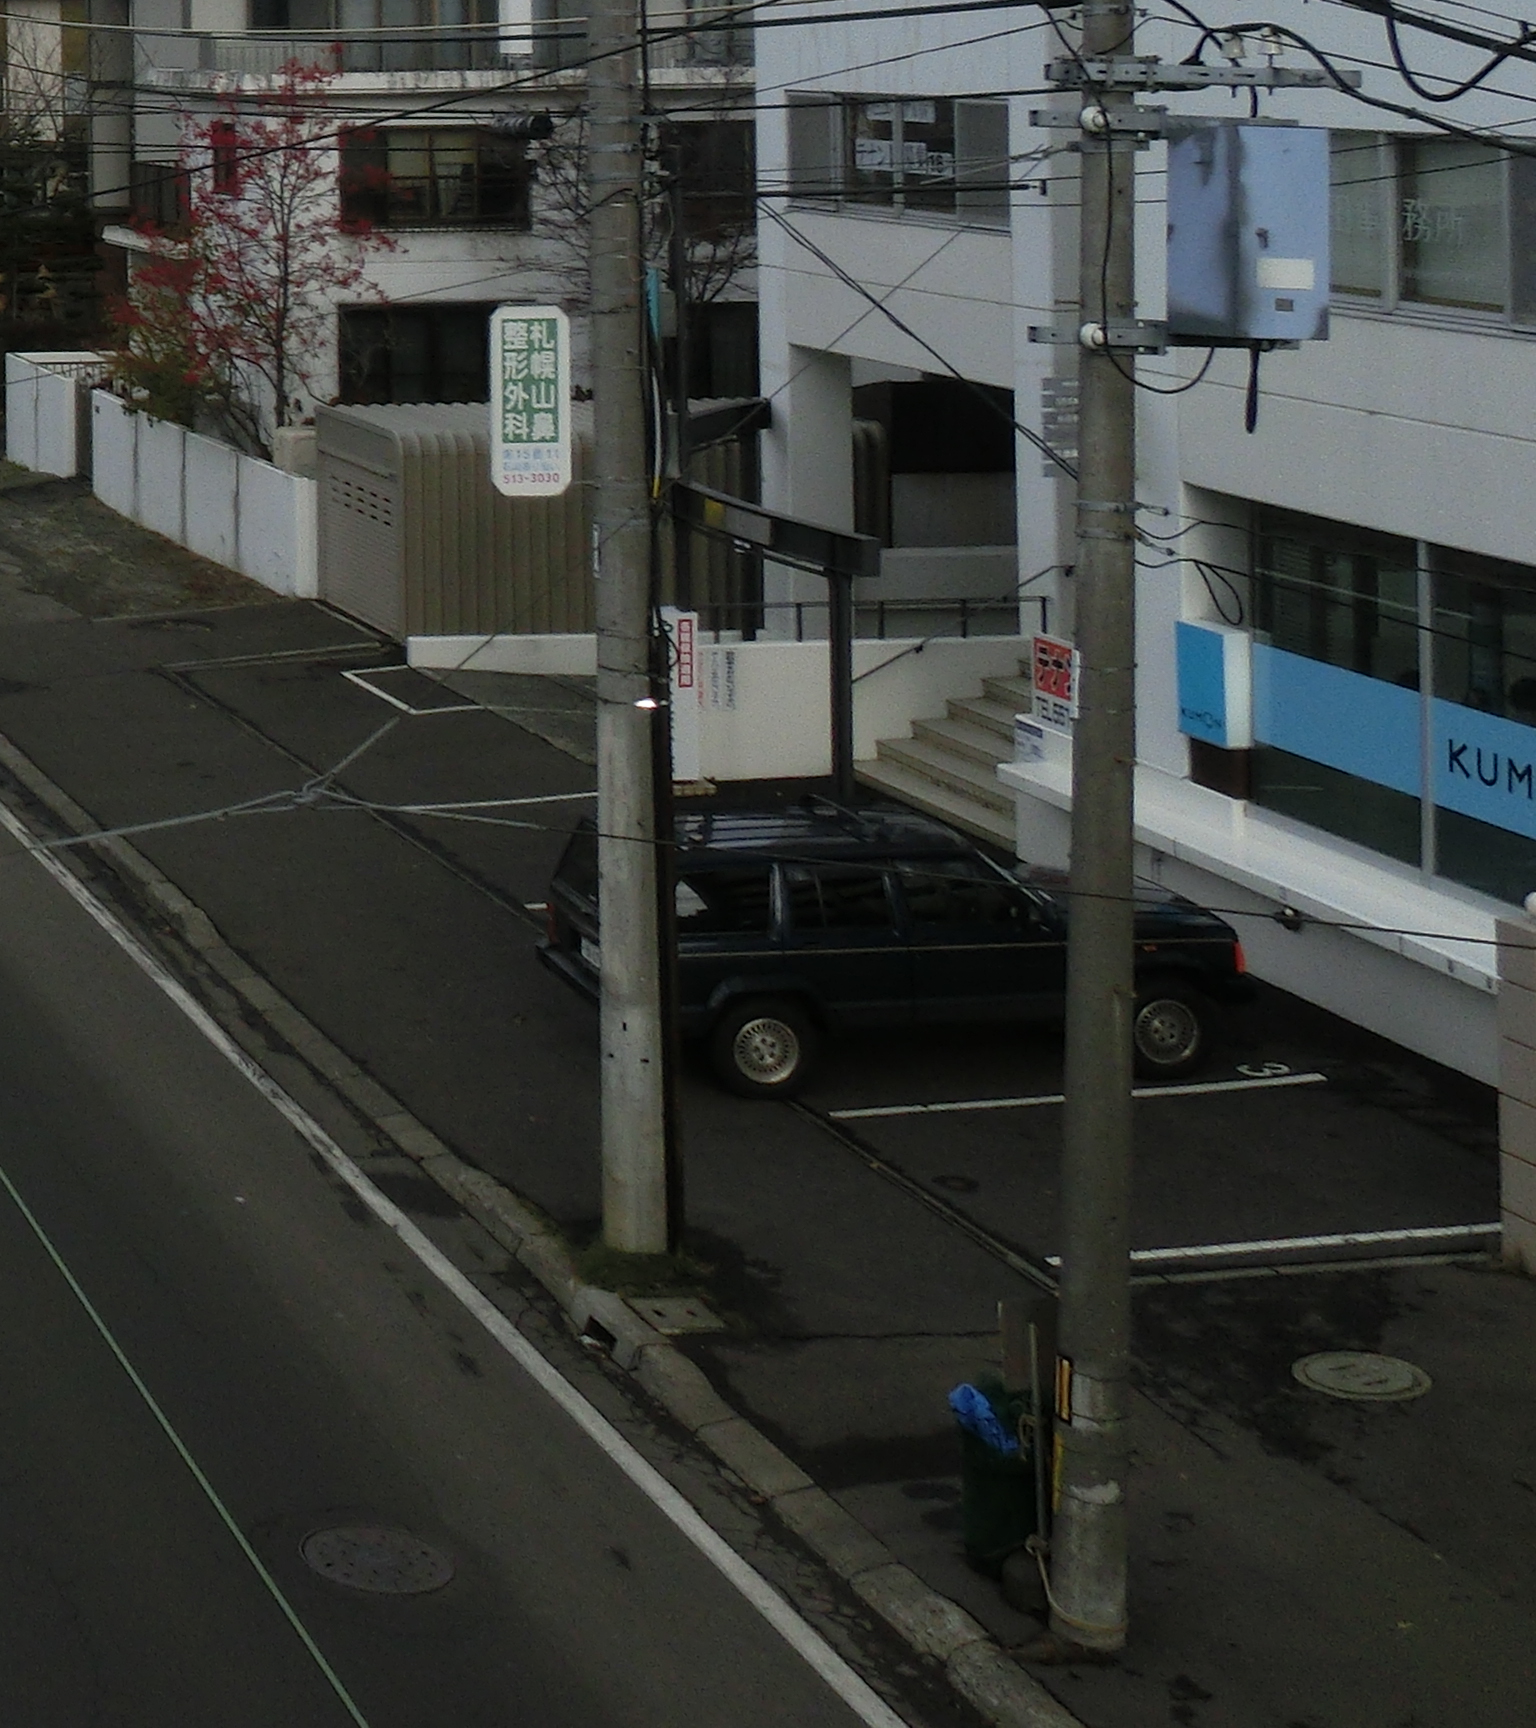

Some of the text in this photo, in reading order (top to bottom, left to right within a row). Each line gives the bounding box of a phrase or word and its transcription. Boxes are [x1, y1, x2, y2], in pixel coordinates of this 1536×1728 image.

[503, 322, 529, 440] 整形外科
[530, 321, 556, 440] 札幌山鼻
[503, 473, 560, 484] 513-3030
[1448, 738, 1535, 800] KUM
